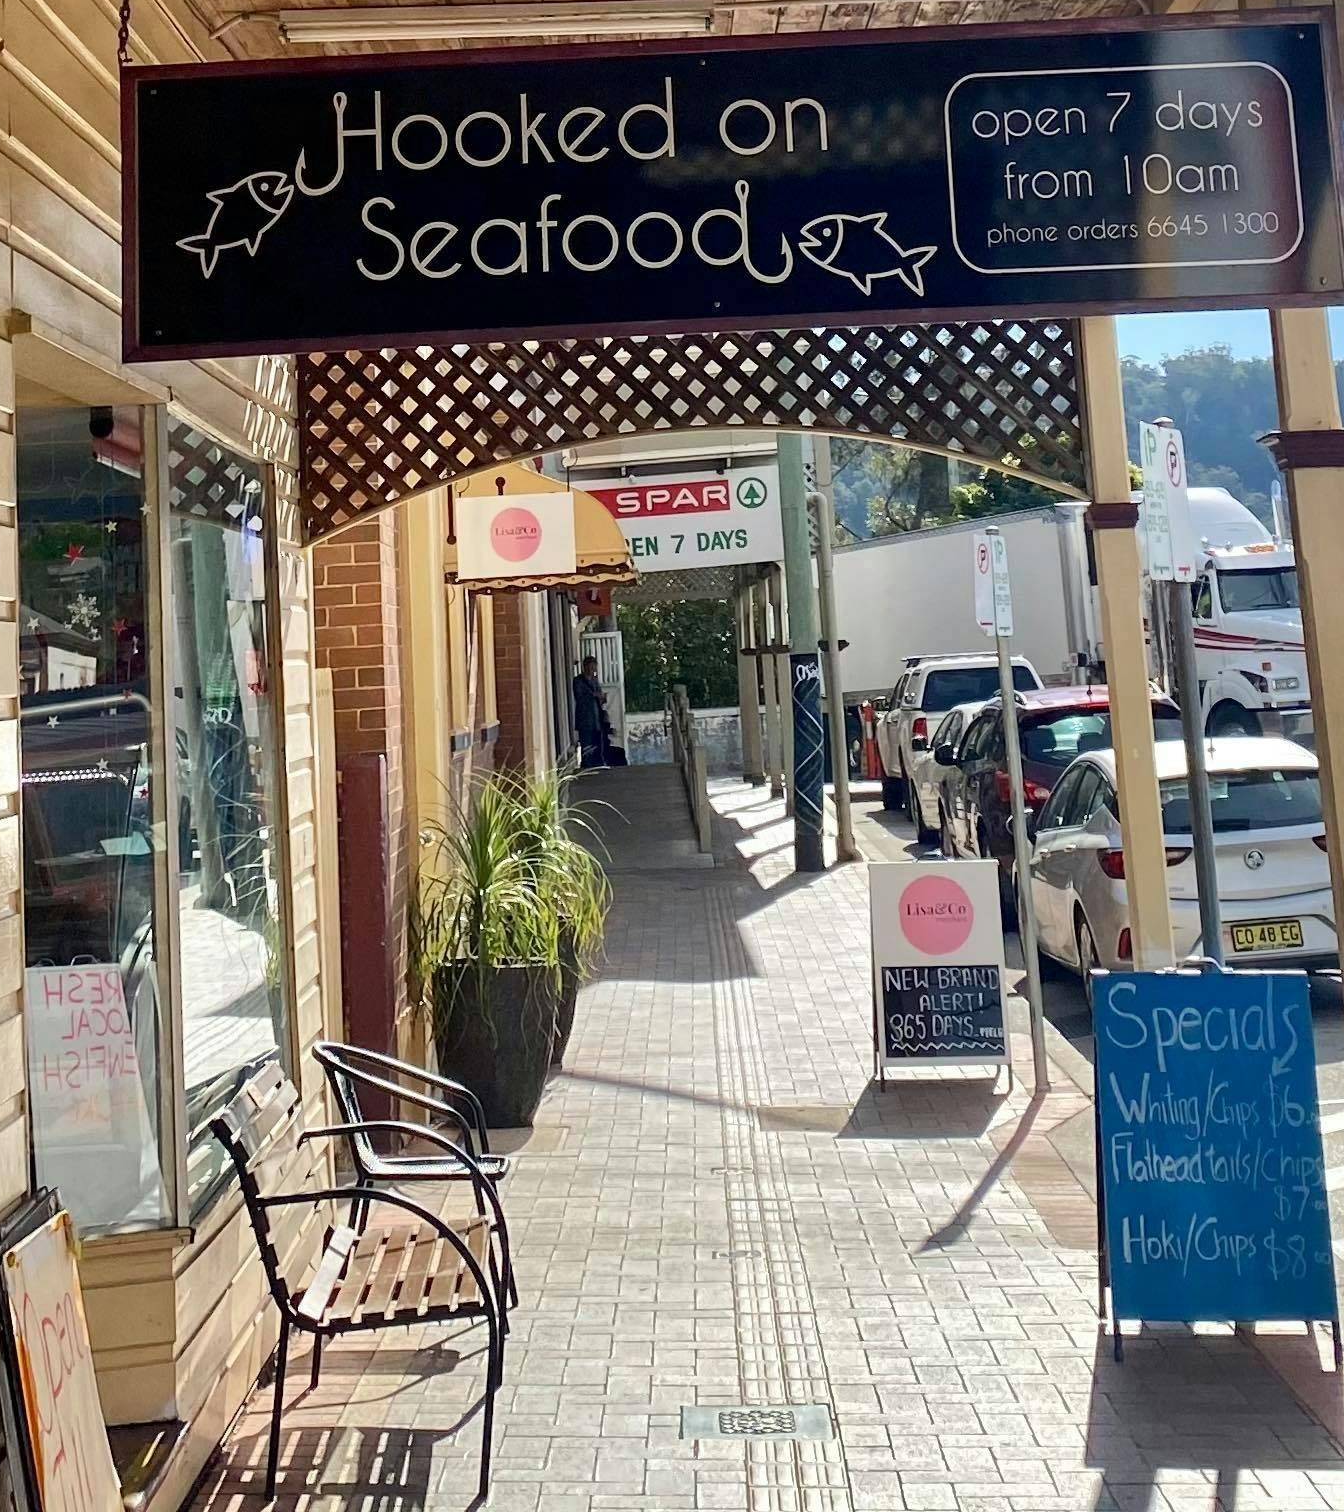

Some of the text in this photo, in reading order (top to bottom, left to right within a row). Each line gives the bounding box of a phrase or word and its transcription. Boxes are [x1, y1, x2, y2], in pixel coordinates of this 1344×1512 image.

[972, 89, 1264, 146] open 7 days
[295, 76, 828, 196] Hooked on
[1004, 153, 1239, 200] from 10am
[357, 179, 793, 284] Seafood
[987, 211, 1280, 248] phone orders 6645 1300
[616, 485, 728, 513] SPAR
[624, 529, 748, 557] EN 7 DAYS
[907, 901, 967, 917] Lisa&Co
[885, 967, 999, 992] NEW BRAND
[919, 992, 985, 1015] ALERT!
[932, 1014, 974, 1037] DAYS
[1106, 975, 1299, 1073] Specials
